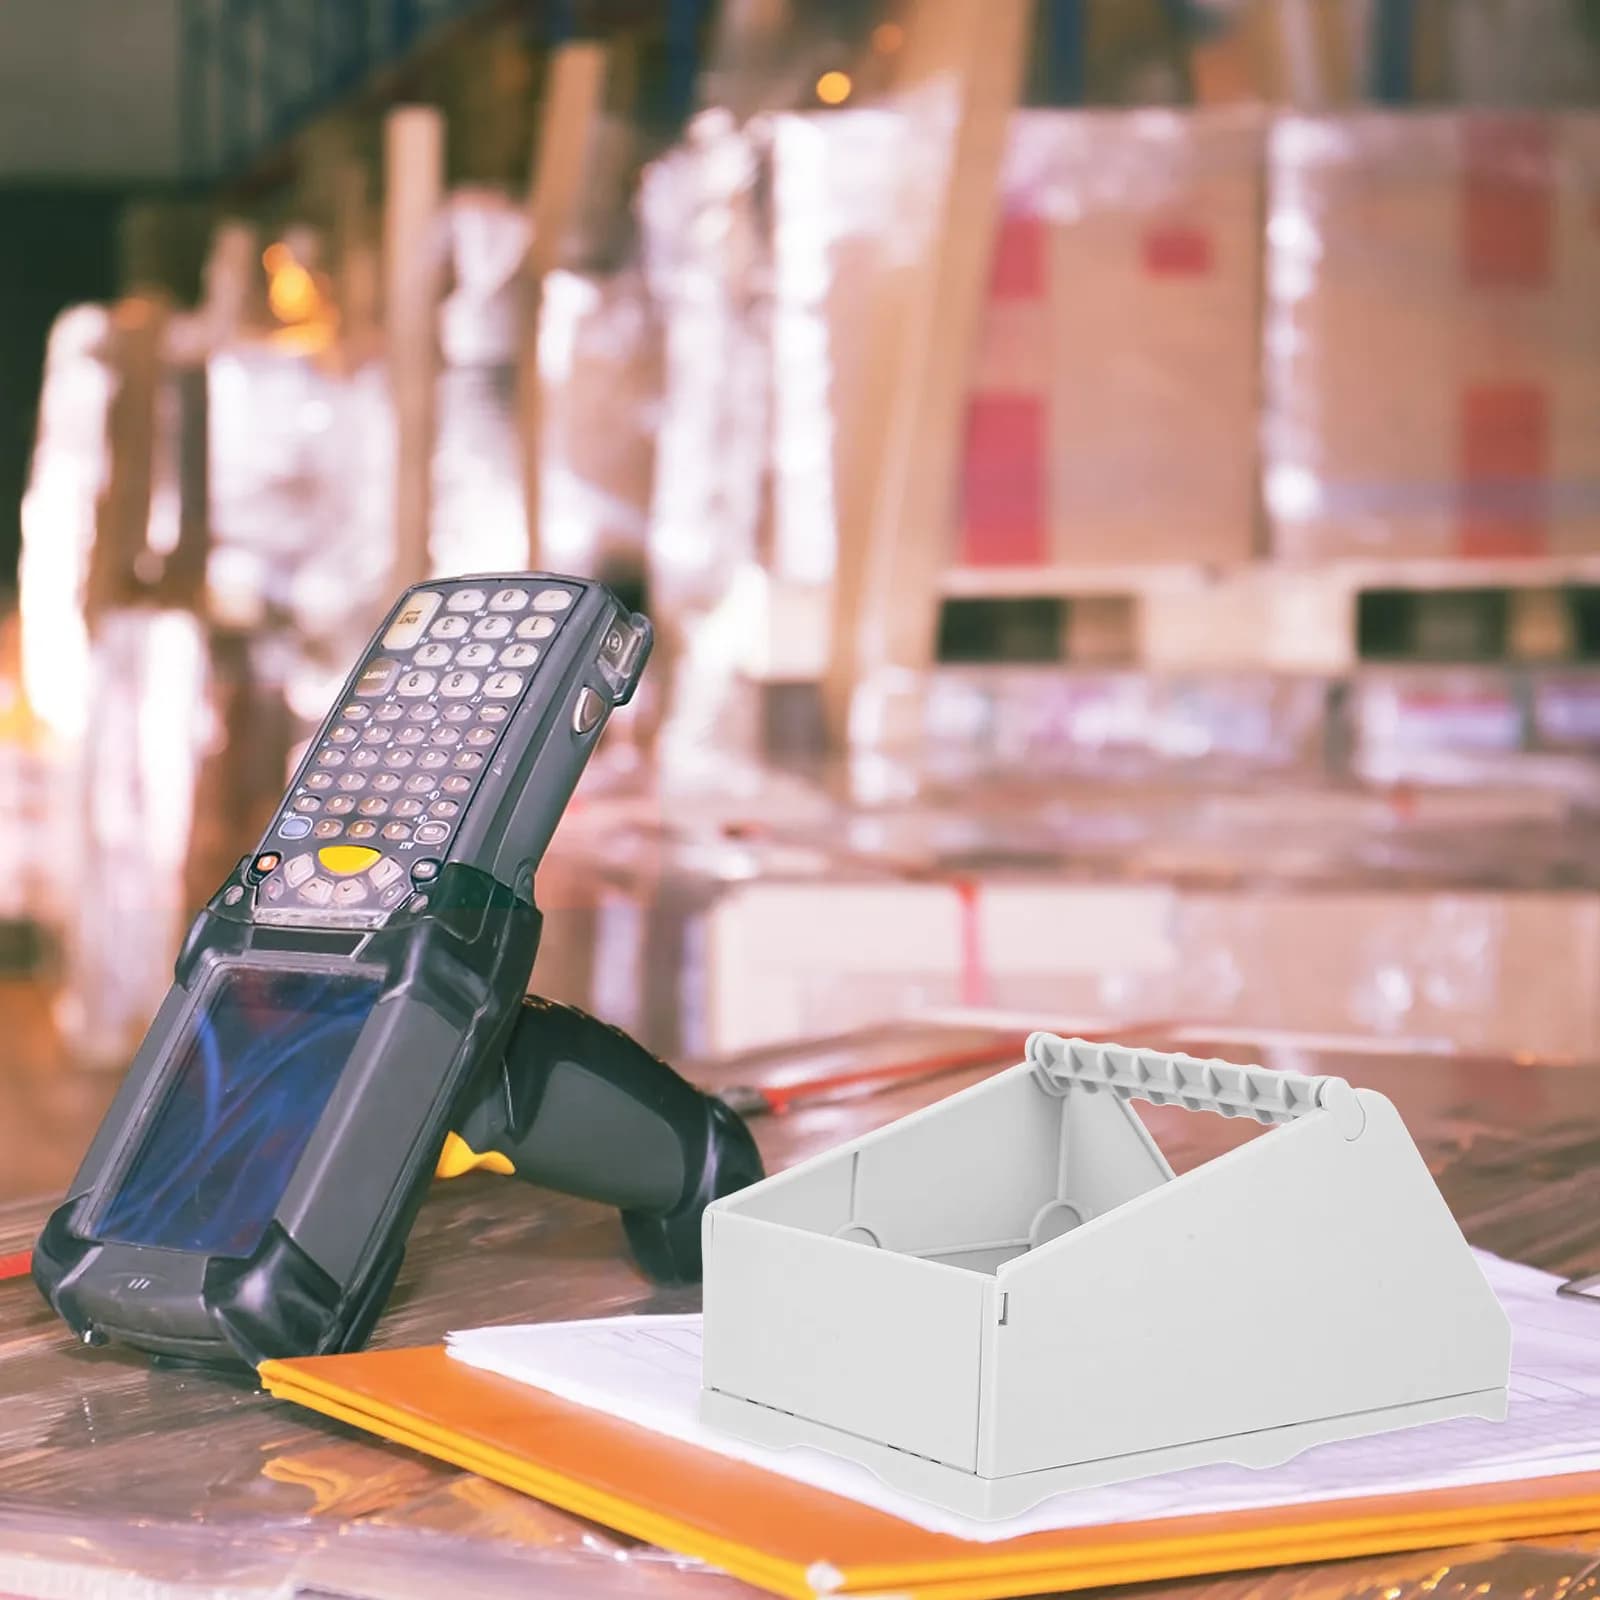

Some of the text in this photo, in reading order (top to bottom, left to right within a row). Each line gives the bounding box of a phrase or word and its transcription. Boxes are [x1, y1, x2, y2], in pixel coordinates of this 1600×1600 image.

[503, 592, 513, 601] 0
[398, 616, 418, 624] ENT
[442, 619, 454, 630] 3
[484, 619, 496, 630] 2
[528, 619, 538, 630] 1
[426, 646, 438, 657] 6
[468, 646, 481, 657] 5
[513, 647, 525, 658] 4
[363, 670, 389, 679] SHIFT
[409, 674, 419, 687] 9
[452, 674, 462, 687] 8
[495, 677, 505, 688] 7
